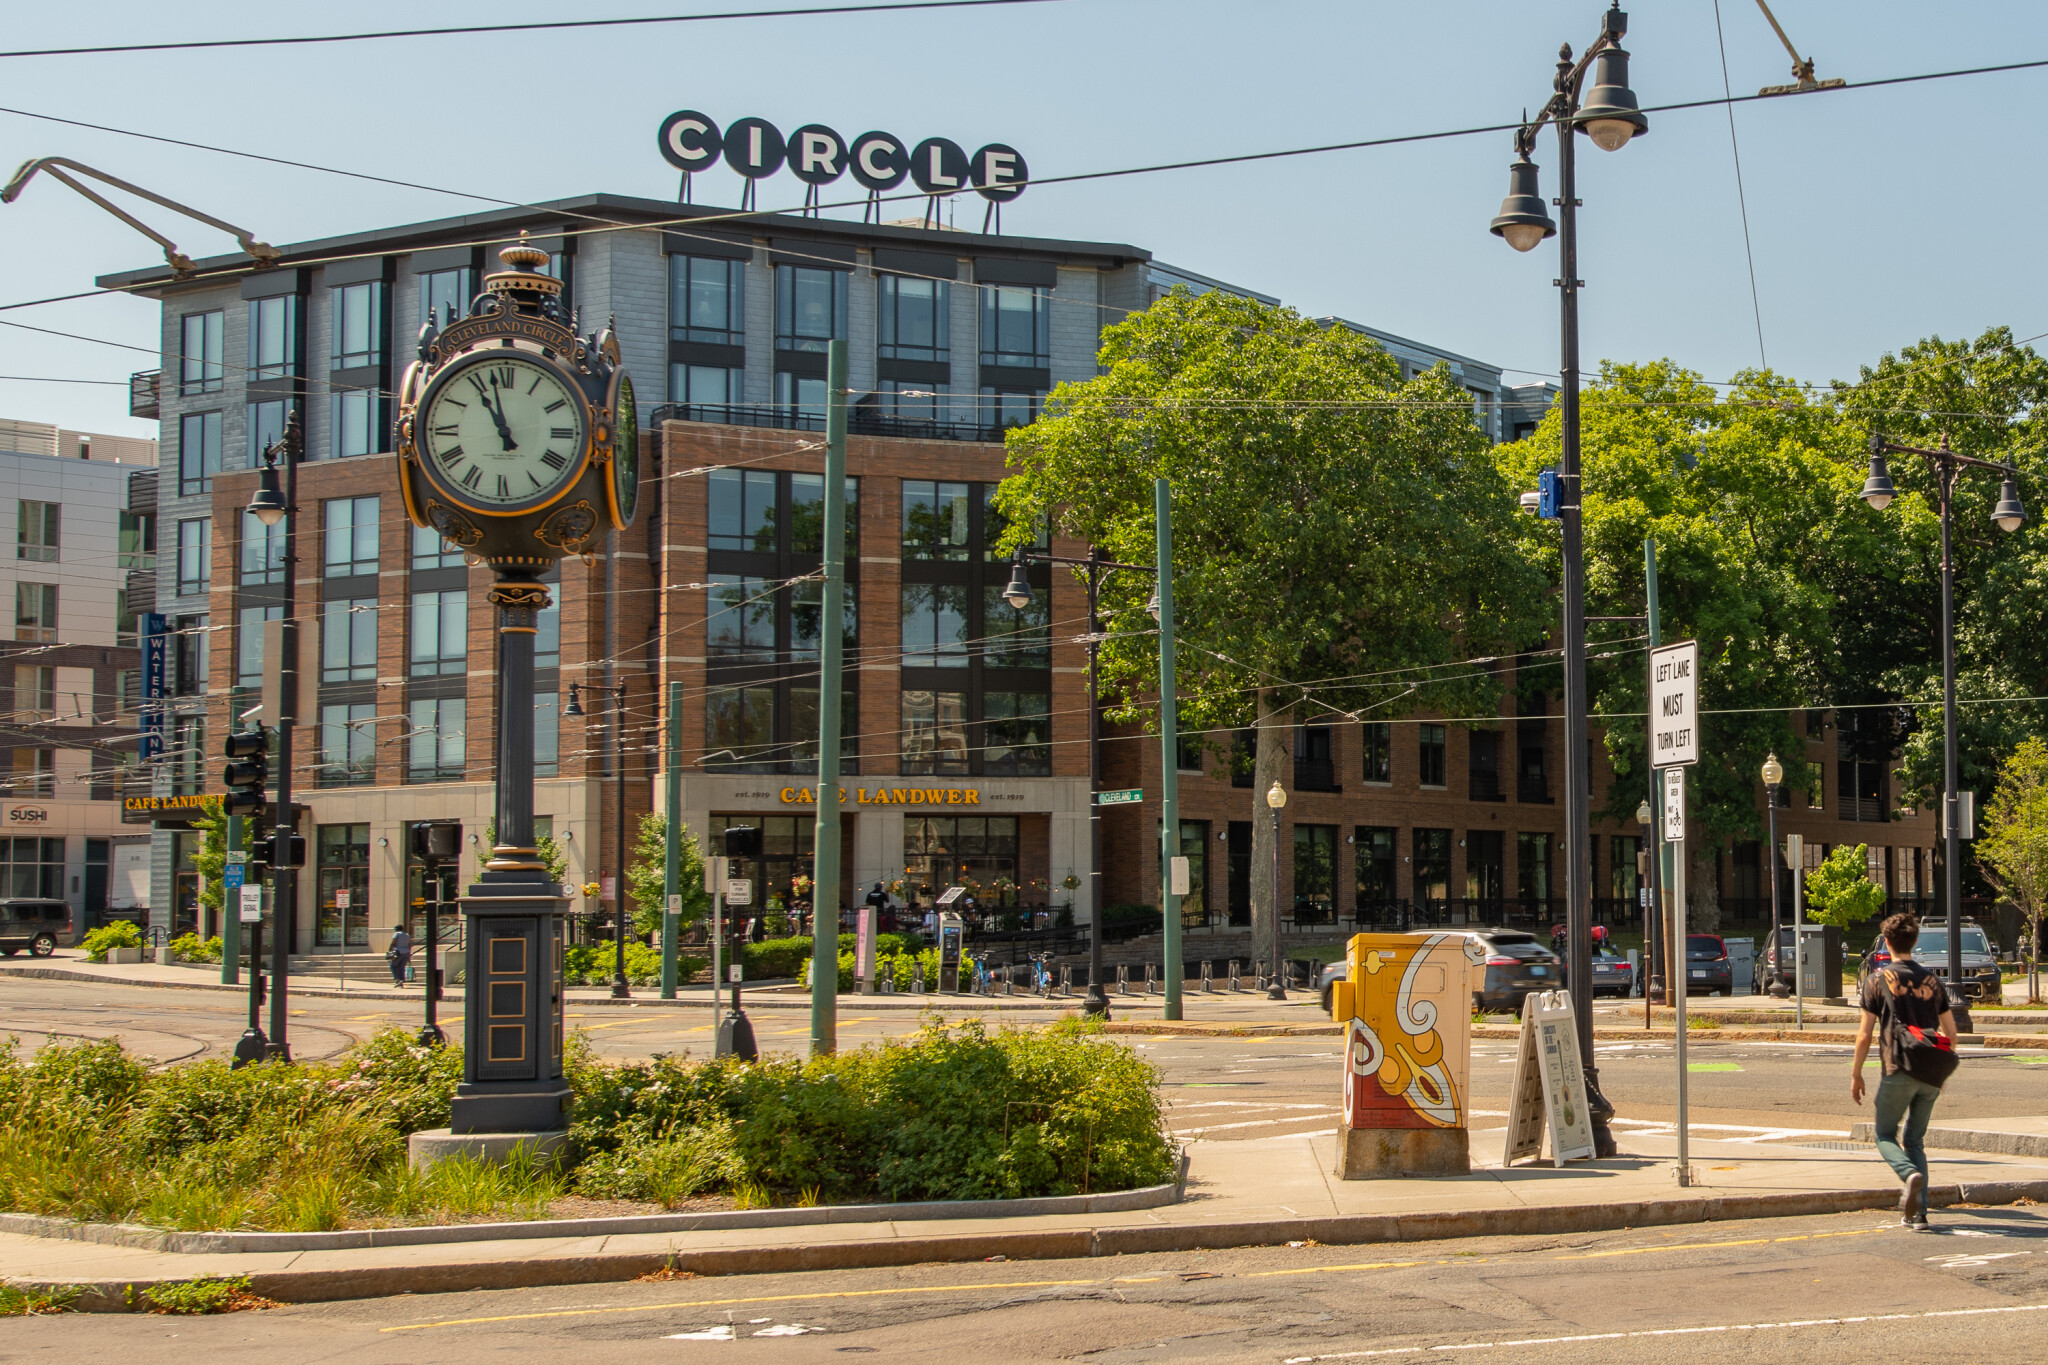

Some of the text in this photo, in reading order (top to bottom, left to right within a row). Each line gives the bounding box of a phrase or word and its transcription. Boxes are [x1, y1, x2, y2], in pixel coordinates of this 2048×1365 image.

[667, 118, 1018, 193] CIRCLE
[449, 320, 566, 346] CLEVELAND CIRCLE
[1656, 659, 1690, 683] LEFT LANE
[1663, 693, 1683, 717] MUST
[1657, 728, 1690, 750] TURN LEFT
[125, 797, 160, 810] CAFE
[857, 788, 981, 805] LANDWER
[1104, 791, 1132, 804] CLEVELAND
[10, 809, 48, 821] SUSHI
